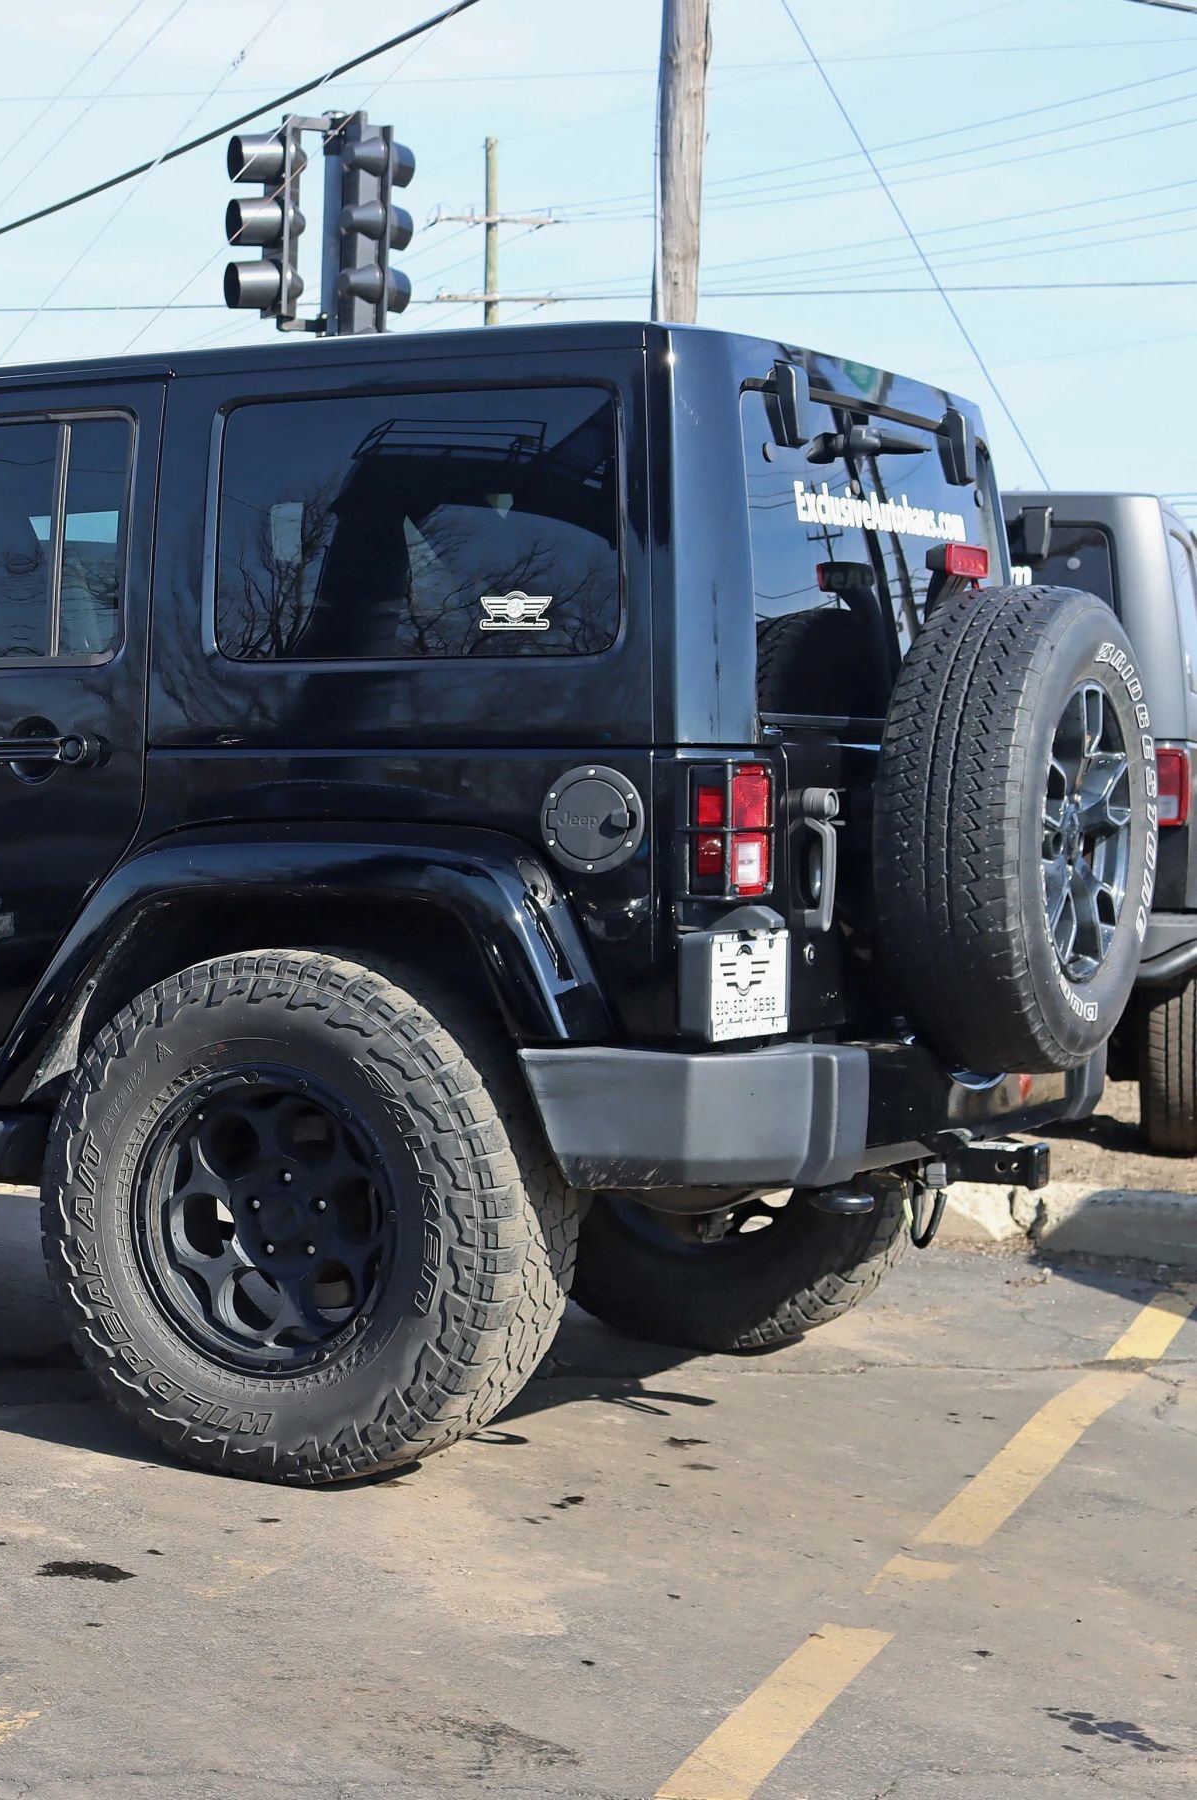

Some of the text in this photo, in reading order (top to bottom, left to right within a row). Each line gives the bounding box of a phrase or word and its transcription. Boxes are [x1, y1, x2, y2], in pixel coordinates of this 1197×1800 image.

[793, 480, 967, 542] ExclusiveAutohaus.com
[558, 810, 600, 831] Jeep
[1093, 642, 1158, 943] BRIDGESTONE
[73, 1131, 105, 1231] A/T
[355, 1057, 441, 1318] FALKEN
[76, 1235, 273, 1435] WILDPEAK
